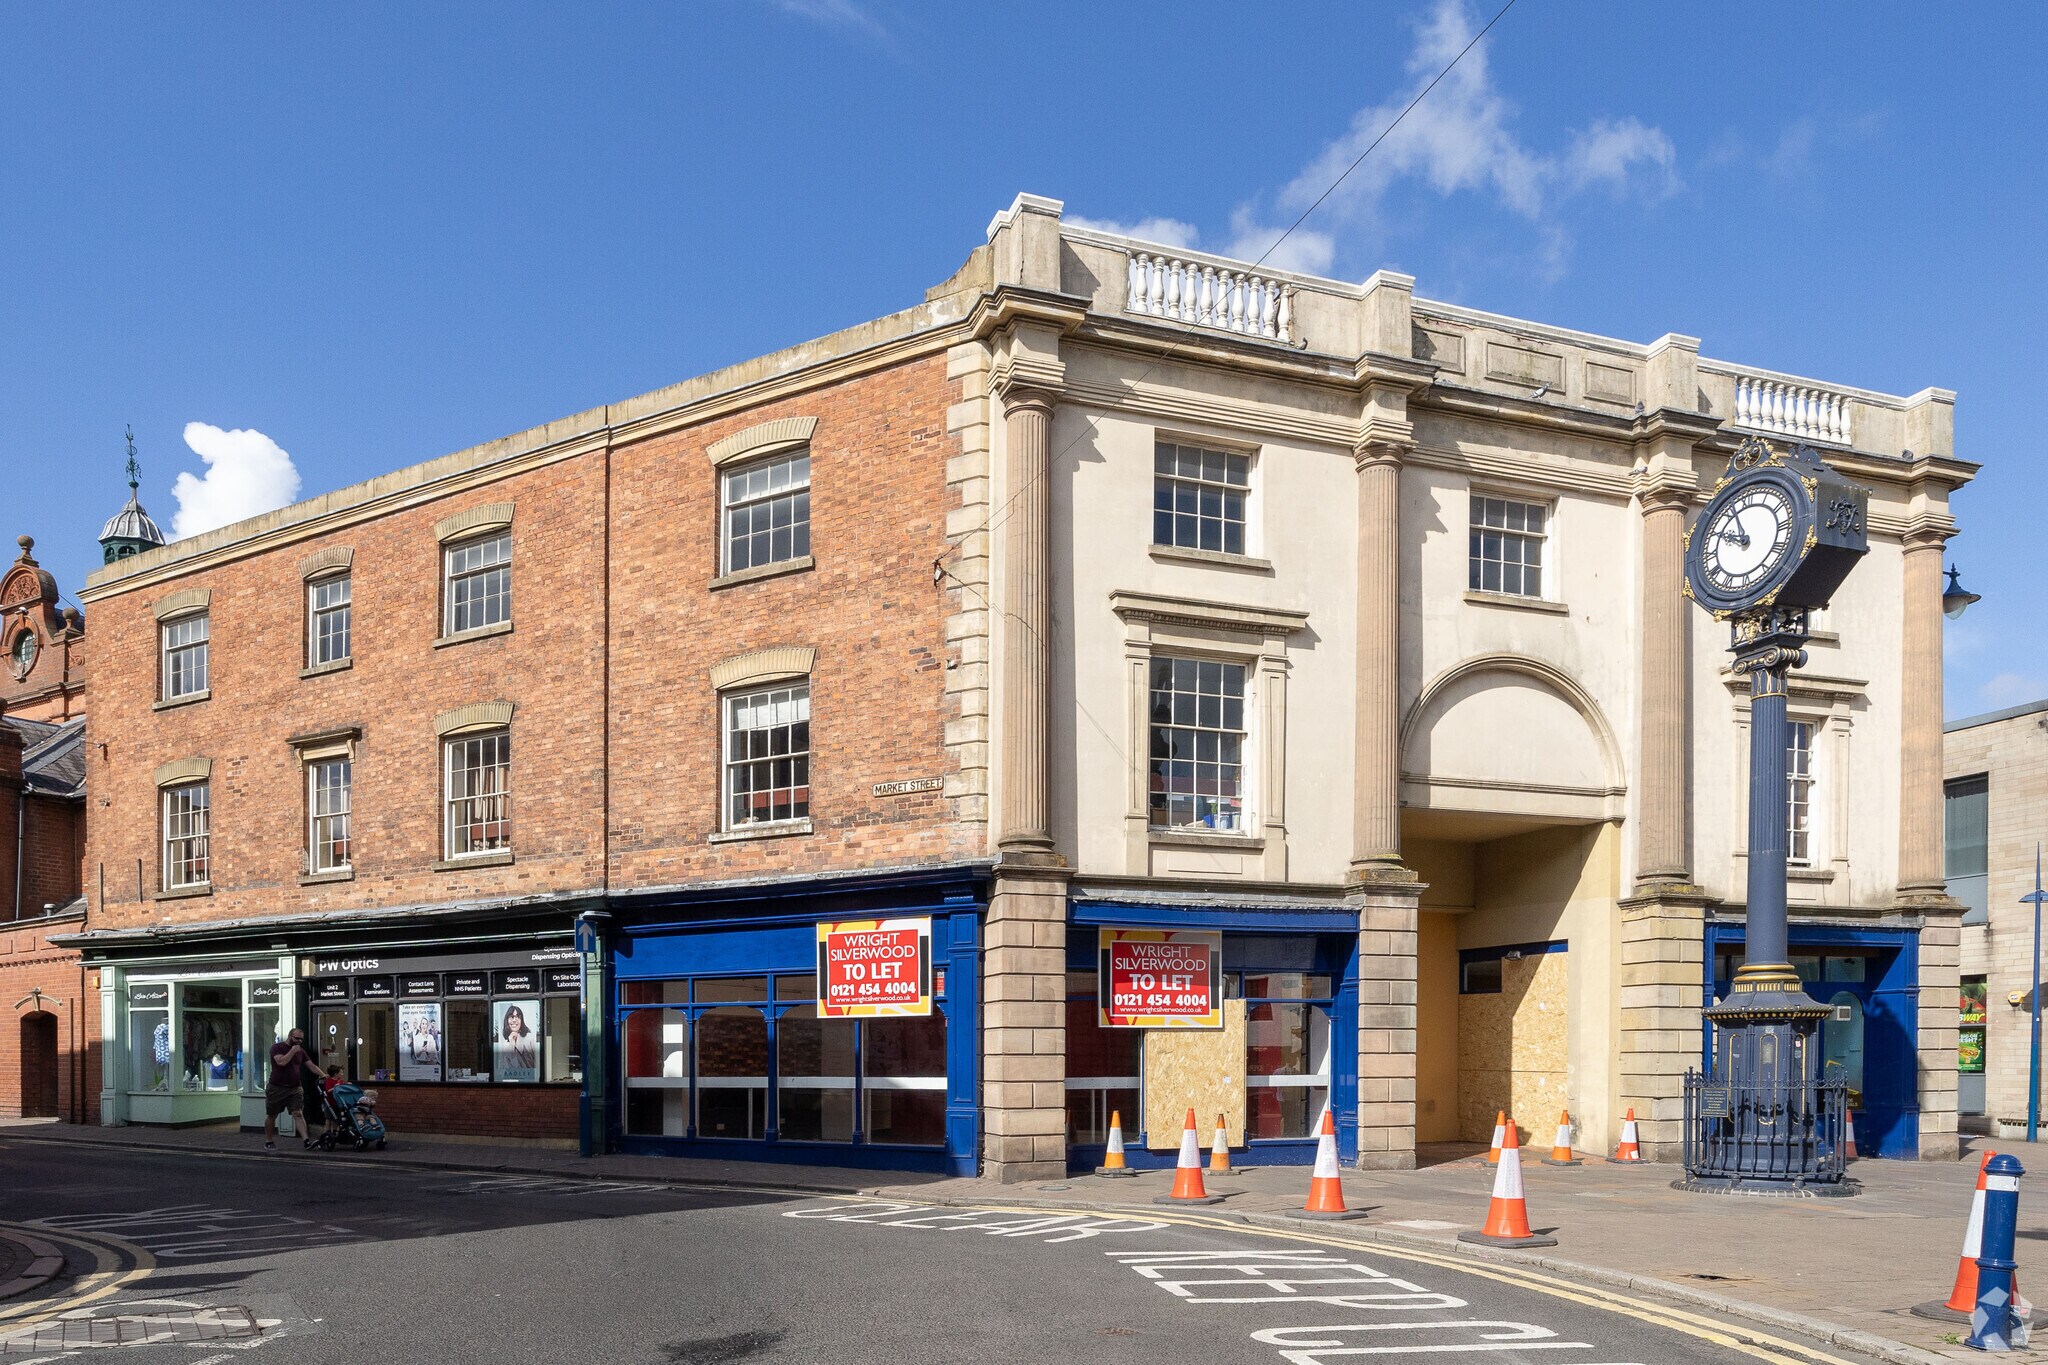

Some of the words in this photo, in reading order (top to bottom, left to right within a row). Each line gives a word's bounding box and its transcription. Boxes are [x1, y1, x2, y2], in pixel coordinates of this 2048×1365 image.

[874, 782, 908, 795] MARKET
[910, 778, 940, 791] STREET
[844, 933, 900, 947] WRIGHT
[532, 953, 560, 961] Dispensing
[561, 951, 580, 959] Opticia
[830, 945, 915, 961] SILVERWOOD
[1131, 945, 1191, 958] WRIGHT
[319, 959, 339, 971] PW
[341, 956, 379, 972] Optics
[1115, 957, 1206, 971] SILVERWOOD
[842, 963, 866, 981] TO
[871, 962, 902, 979] LET
[830, 984, 855, 996] 0121
[858, 983, 880, 995] 454
[884, 982, 916, 994] 4004
[1129, 973, 1155, 991] TO
[1161, 974, 1193, 991] LET
[835, 995, 911, 1003] www.wrightsilverwood.co.uk
[1114, 994, 1142, 1006] 0121
[1146, 994, 1171, 1006] 454
[1175, 994, 1207, 1006] 4004
[1119, 1006, 1202, 1014] www.wrightsilverwood.co.uk
[782, 1203, 1171, 1243] CLEAR
[1104, 1250, 1470, 1310] KEEP
